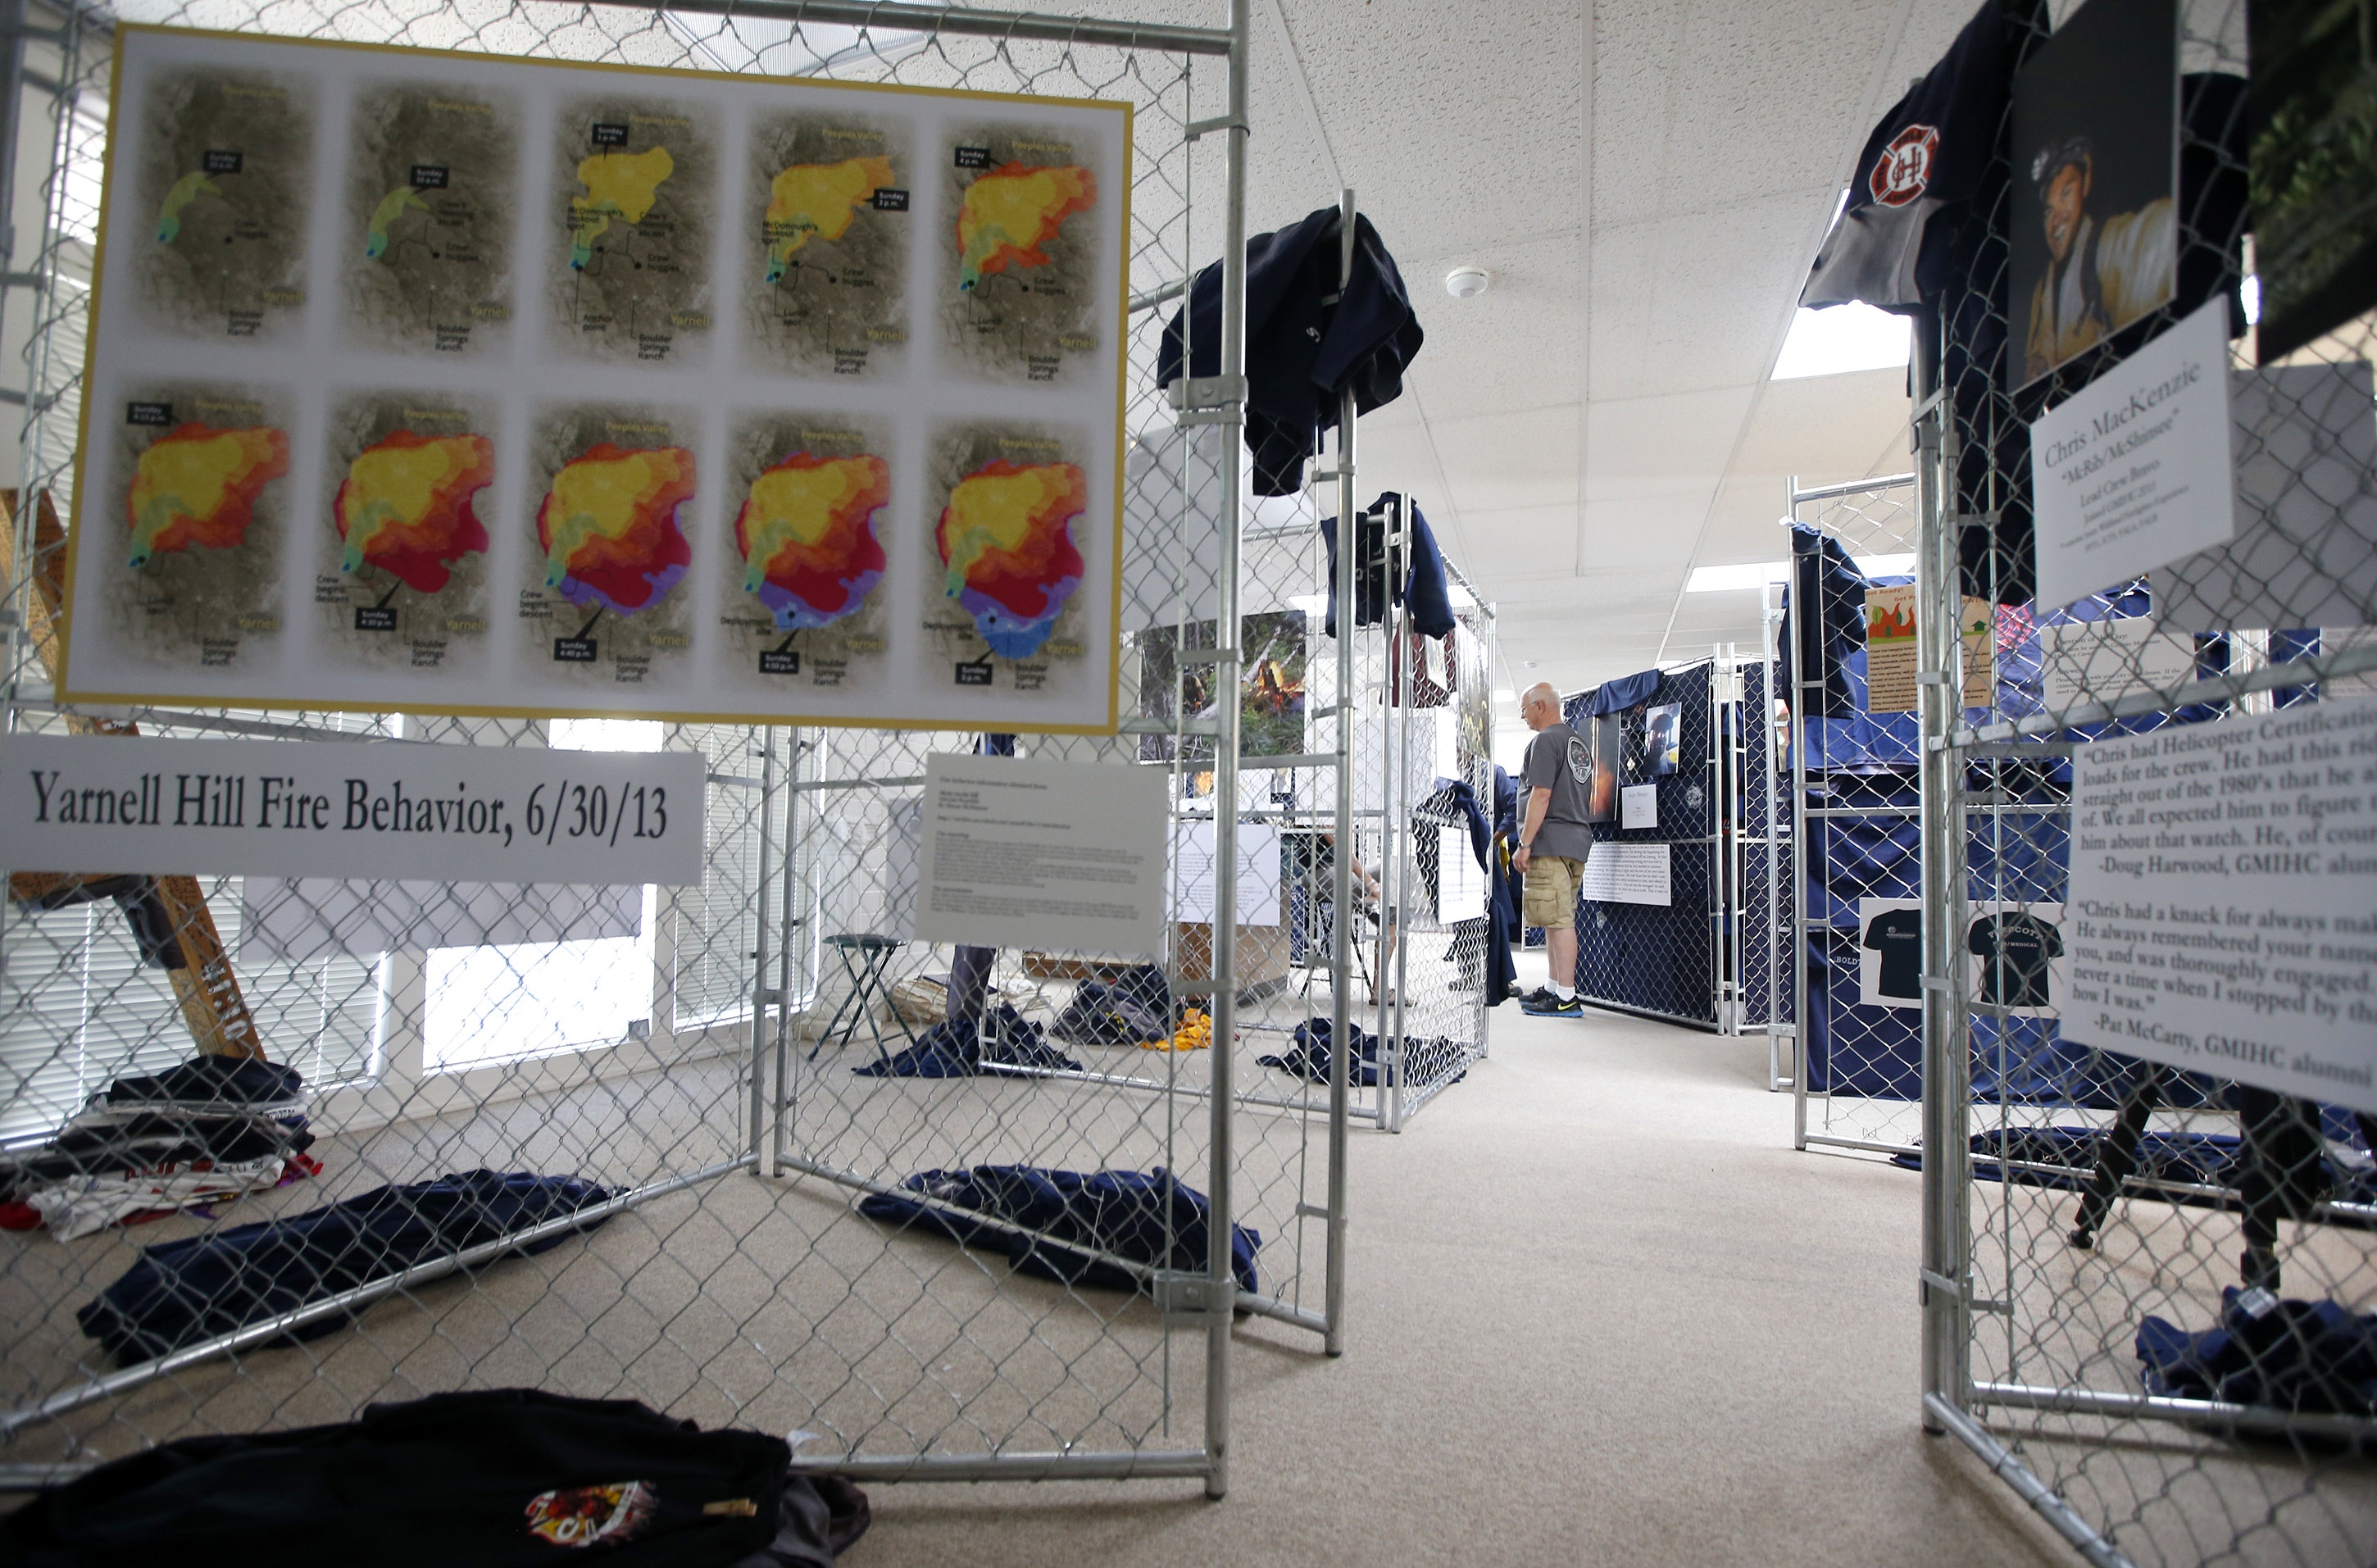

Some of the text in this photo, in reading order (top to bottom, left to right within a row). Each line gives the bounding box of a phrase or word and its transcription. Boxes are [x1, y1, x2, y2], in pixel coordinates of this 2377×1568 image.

[879, 192, 904, 202] Sunday
[469, 304, 509, 319] Yarnell
[670, 313, 710, 328] Yarnell
[866, 329, 905, 341] Yarnell
[1058, 335, 1096, 348] Yarnell
[2043, 361, 2201, 469] Chris MacKenzie
[2080, 489, 2102, 508] Lead
[2102, 476, 2128, 496] Crew
[1879, 588, 1903, 596] Ready!
[445, 618, 485, 630] Yarnell
[649, 633, 689, 646] Yarnell
[2083, 769, 2117, 786] loads
[2121, 766, 2140, 782] for
[2145, 762, 2168, 779] the
[2173, 760, 2216, 776] crew.
[2224, 750, 2252, 770] He
[2257, 743, 2293, 766] had
[2302, 739, 2341, 761] this
[2084, 748, 2127, 765] “Chris
[2130, 740, 2158, 757] had
[2163, 729, 2254, 753] Helicopter
[2083, 788, 2133, 811] straight
[2138, 789, 2161, 802] out
[2166, 781, 2183, 799] of
[2187, 779, 2212, 798] the
[2280, 770, 2319, 789] that
[30, 770, 669, 848] Yarnell Hill Fire Behavior, 6/30/13
[2082, 811, 2098, 827] of.
[2102, 811, 2125, 826] We
[2128, 807, 2144, 825] all
[2148, 801, 2221, 828] expected
[2227, 800, 2263, 818] him
[2270, 801, 2289, 816] to
[2297, 793, 2361, 819] figure
[2080, 834, 2106, 850] him
[2110, 834, 2150, 849] about
[2155, 832, 2185, 848] that
[2191, 826, 2247, 847] watch.
[2255, 825, 2292, 847] He,
[2297, 823, 2322, 843] of
[2099, 856, 2144, 879] -Doug
[2147, 853, 2229, 877] Harwood,
[2235, 852, 2320, 875] GMIHC
[2077, 900, 2120, 919] “Chris
[2125, 902, 2152, 920] had
[2156, 908, 2165, 921] a
[2170, 903, 2220, 925] knack
[2226, 906, 2252, 927] for
[2257, 907, 2326, 937] always
[2076, 920, 2097, 939] He
[2100, 924, 2146, 944] always
[2151, 930, 2260, 952] remembered
[2266, 941, 2312, 961] your
[2075, 944, 2376, 995] you, and was thoroughly engaged.
[2072, 984, 2099, 1002] how
[2104, 989, 2110, 1006] I
[2074, 966, 2109, 984] never
[2112, 974, 2121, 986] a
[2125, 970, 2159, 990] time
[2163, 975, 2207, 998] when
[2214, 980, 2220, 1001] I
[2227, 989, 2307, 1016] stopped
[2313, 993, 2338, 1025] by
[2094, 1013, 2373, 1089] -Pat McCarty, GMIHC alumni
